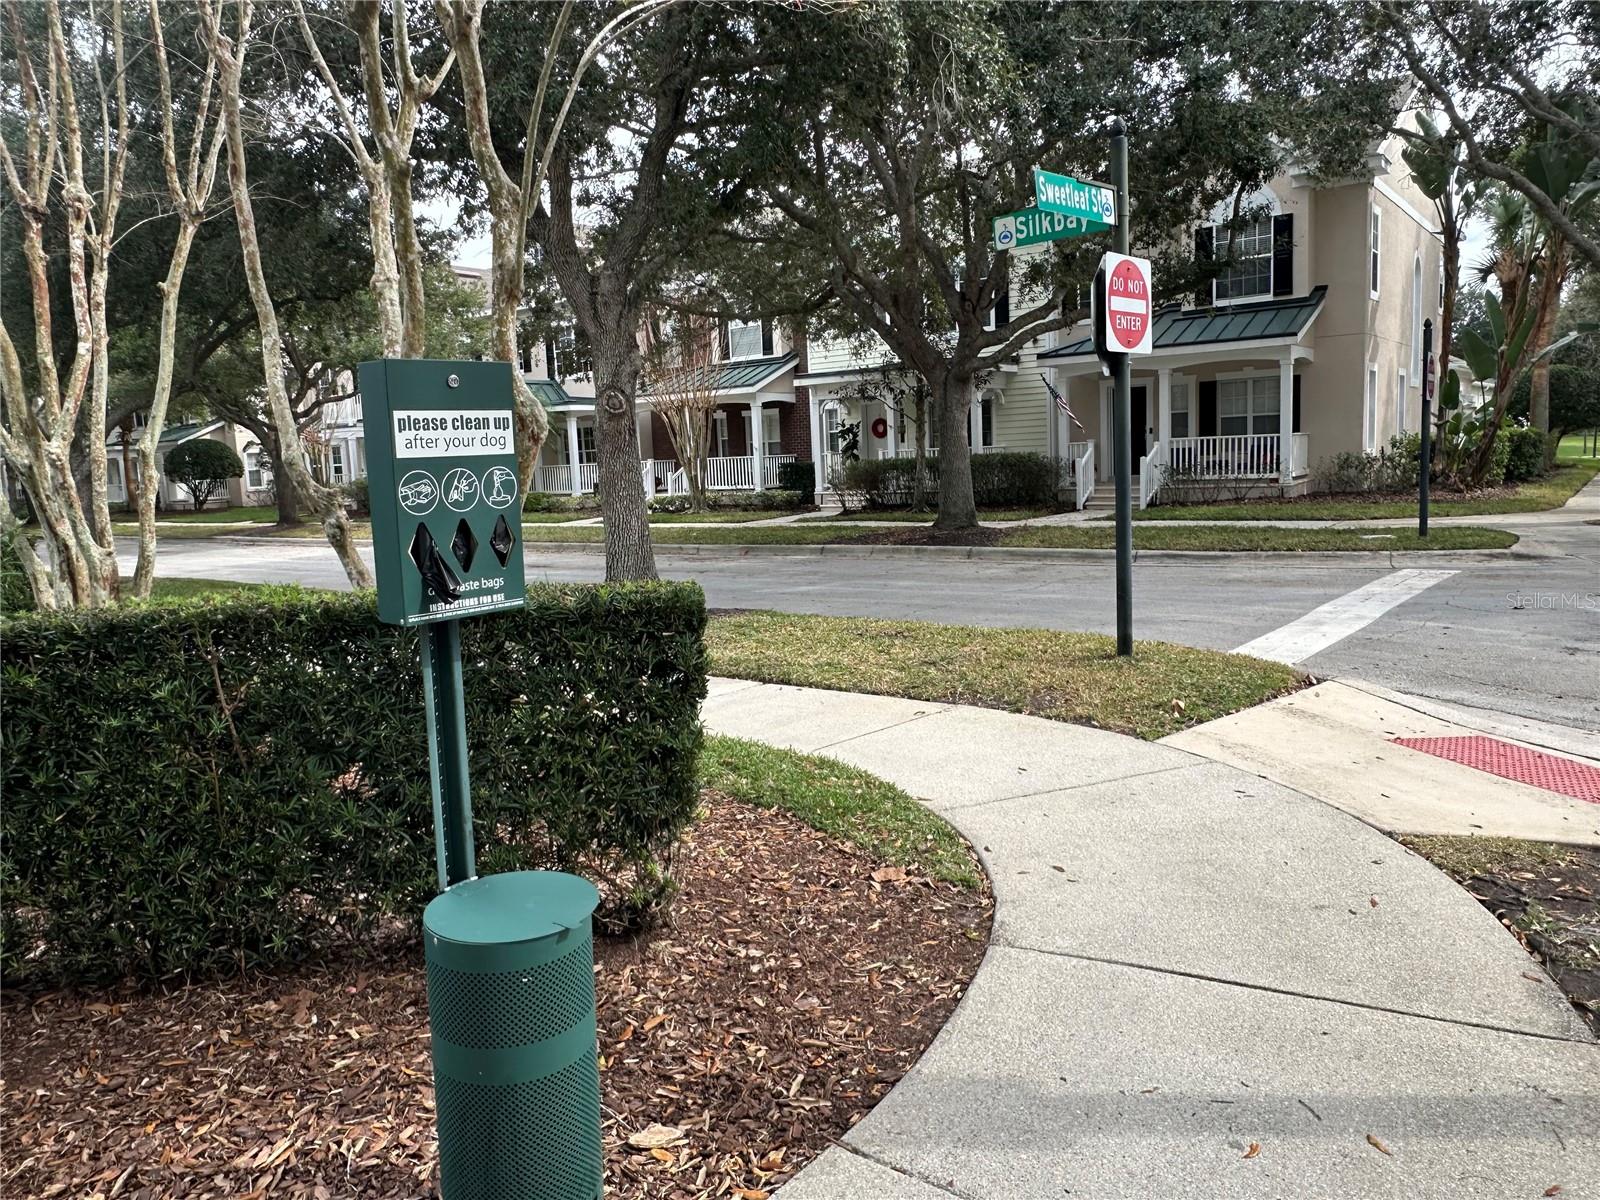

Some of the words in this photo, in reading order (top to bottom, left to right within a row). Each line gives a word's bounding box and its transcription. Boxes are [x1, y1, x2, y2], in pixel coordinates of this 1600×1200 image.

[1039, 175, 1090, 212] Sweetleaf
[1091, 187, 1103, 214] St
[1016, 211, 1088, 239] Silkbay
[1112, 276, 1124, 292] DO
[1128, 279, 1144, 295] NOT
[1116, 314, 1142, 331] ENTER
[397, 415, 448, 433] please
[451, 414, 490, 431] clean
[493, 416, 510, 432] up
[404, 433, 440, 449] after
[443, 435, 477, 452] your
[480, 432, 507, 450] dog
[481, 576, 505, 591] bags
[479, 595, 492, 605] FOR
[493, 592, 505, 602] USE
